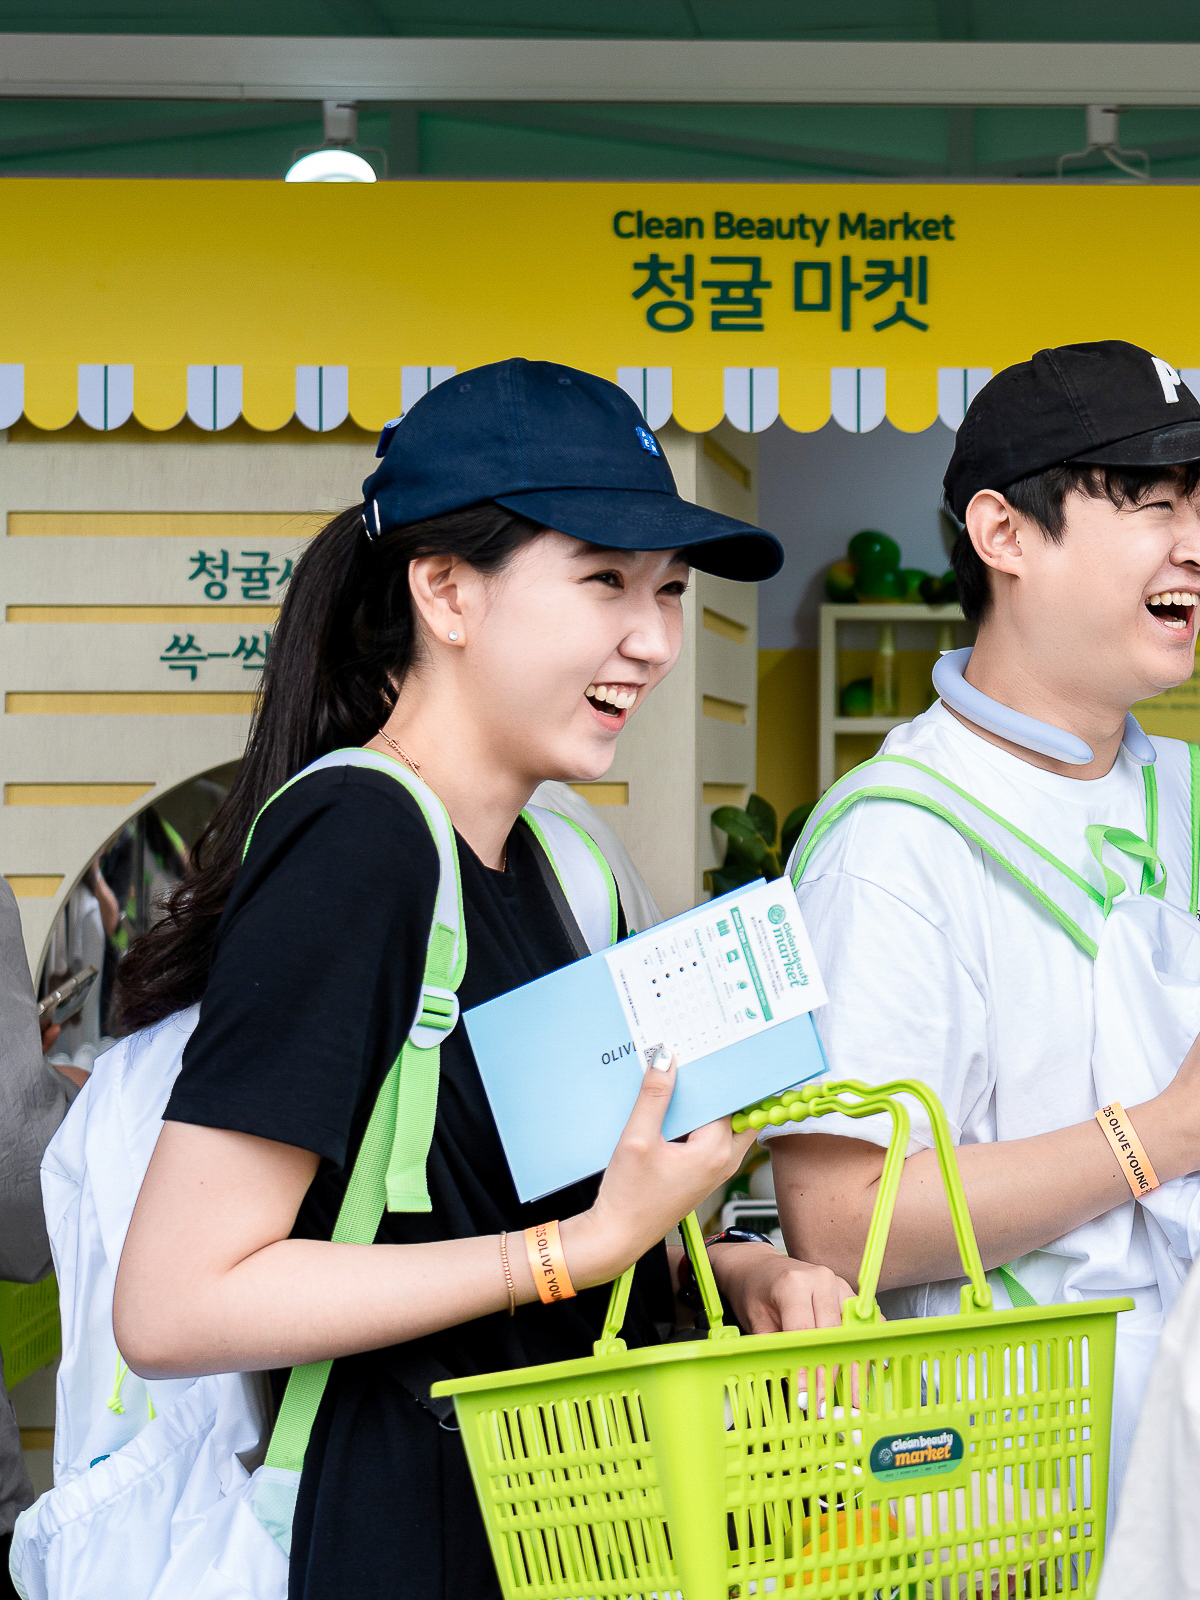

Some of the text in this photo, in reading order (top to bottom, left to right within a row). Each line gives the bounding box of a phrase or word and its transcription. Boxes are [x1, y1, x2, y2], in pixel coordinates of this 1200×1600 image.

[613, 209, 955, 247] Clean Beauty Market
[632, 253, 930, 333] 청귤 마켓
[1151, 356, 1181, 404] P
[773, 926, 799, 988] market
[1109, 1118, 1131, 1152] OLIVE
[1126, 1151, 1149, 1190] YOUNG
[537, 1238, 555, 1277] OLIVE
[894, 1444, 952, 1467] market
